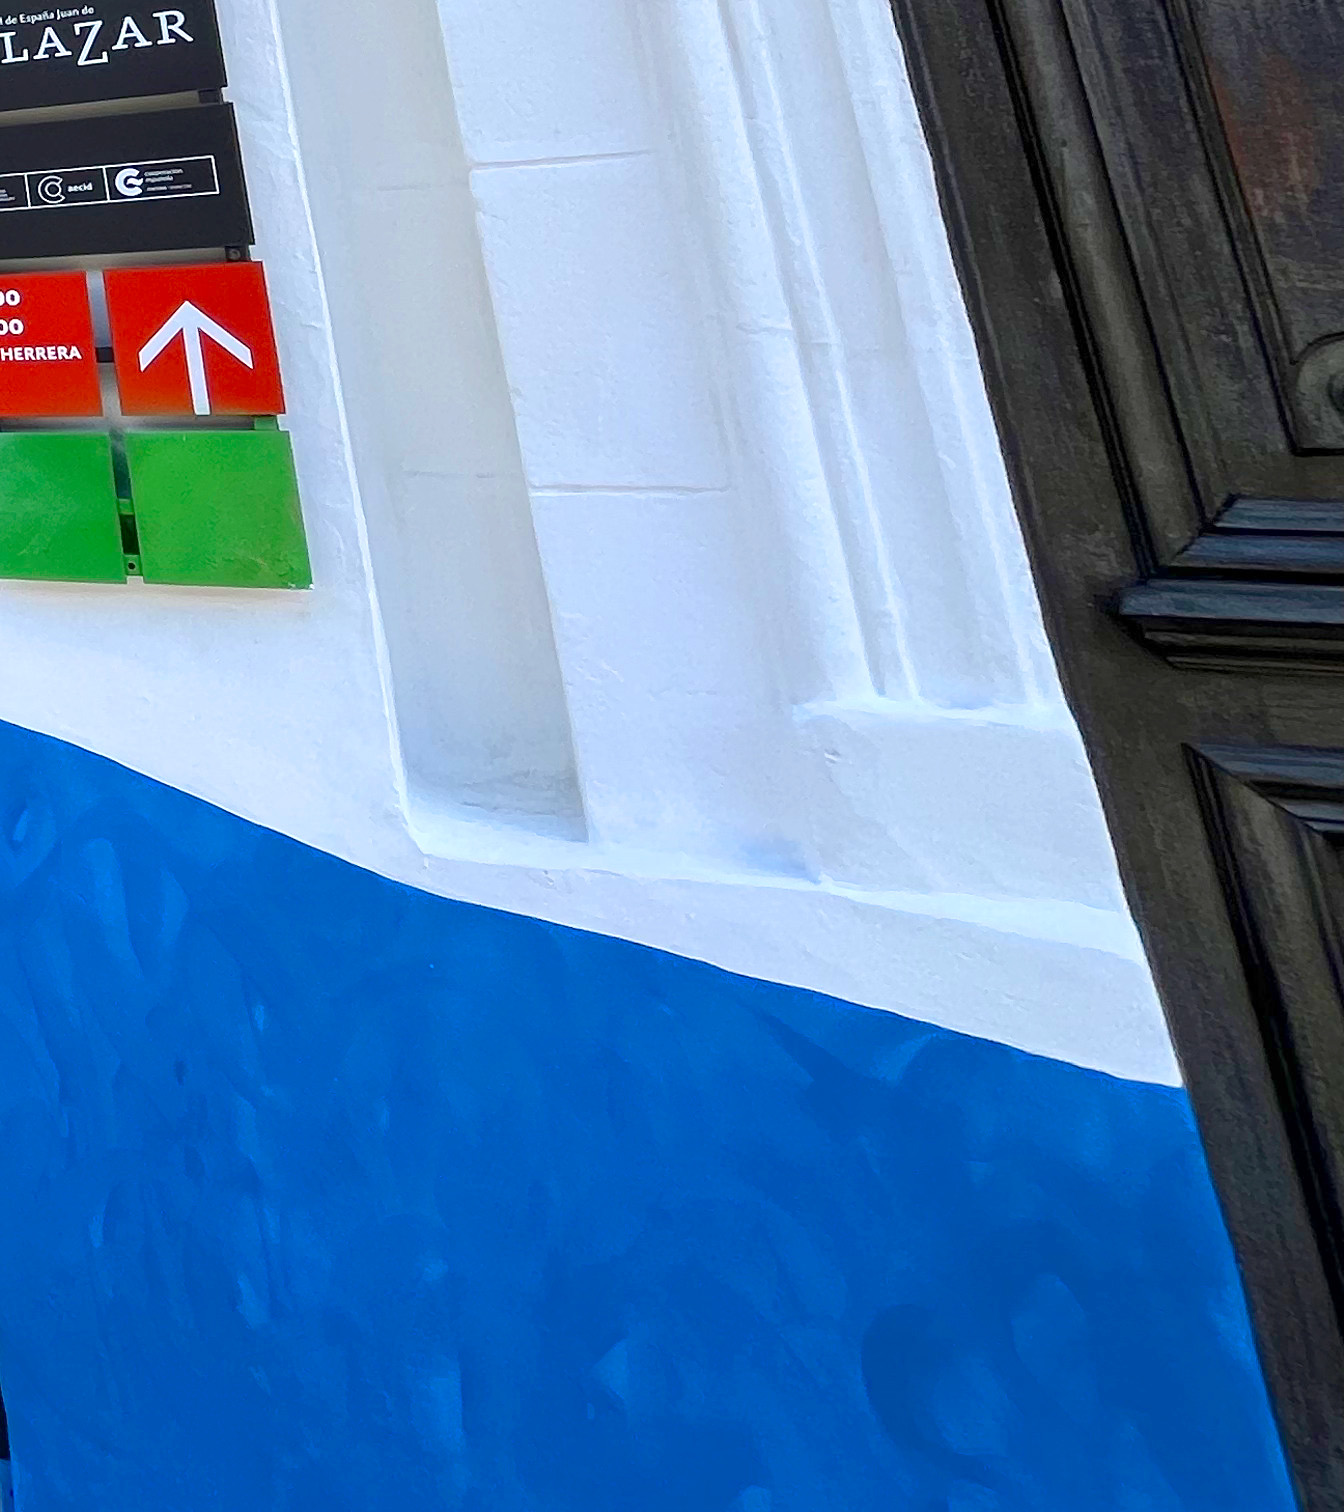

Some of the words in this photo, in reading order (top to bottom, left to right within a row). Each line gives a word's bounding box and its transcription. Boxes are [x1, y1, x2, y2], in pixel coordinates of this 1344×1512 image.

[4, 14, 18, 25] de
[19, 10, 54, 25] España
[56, 8, 79, 21] Juan
[81, 5, 94, 15] de
[1, 345, 82, 361] HERRERA
